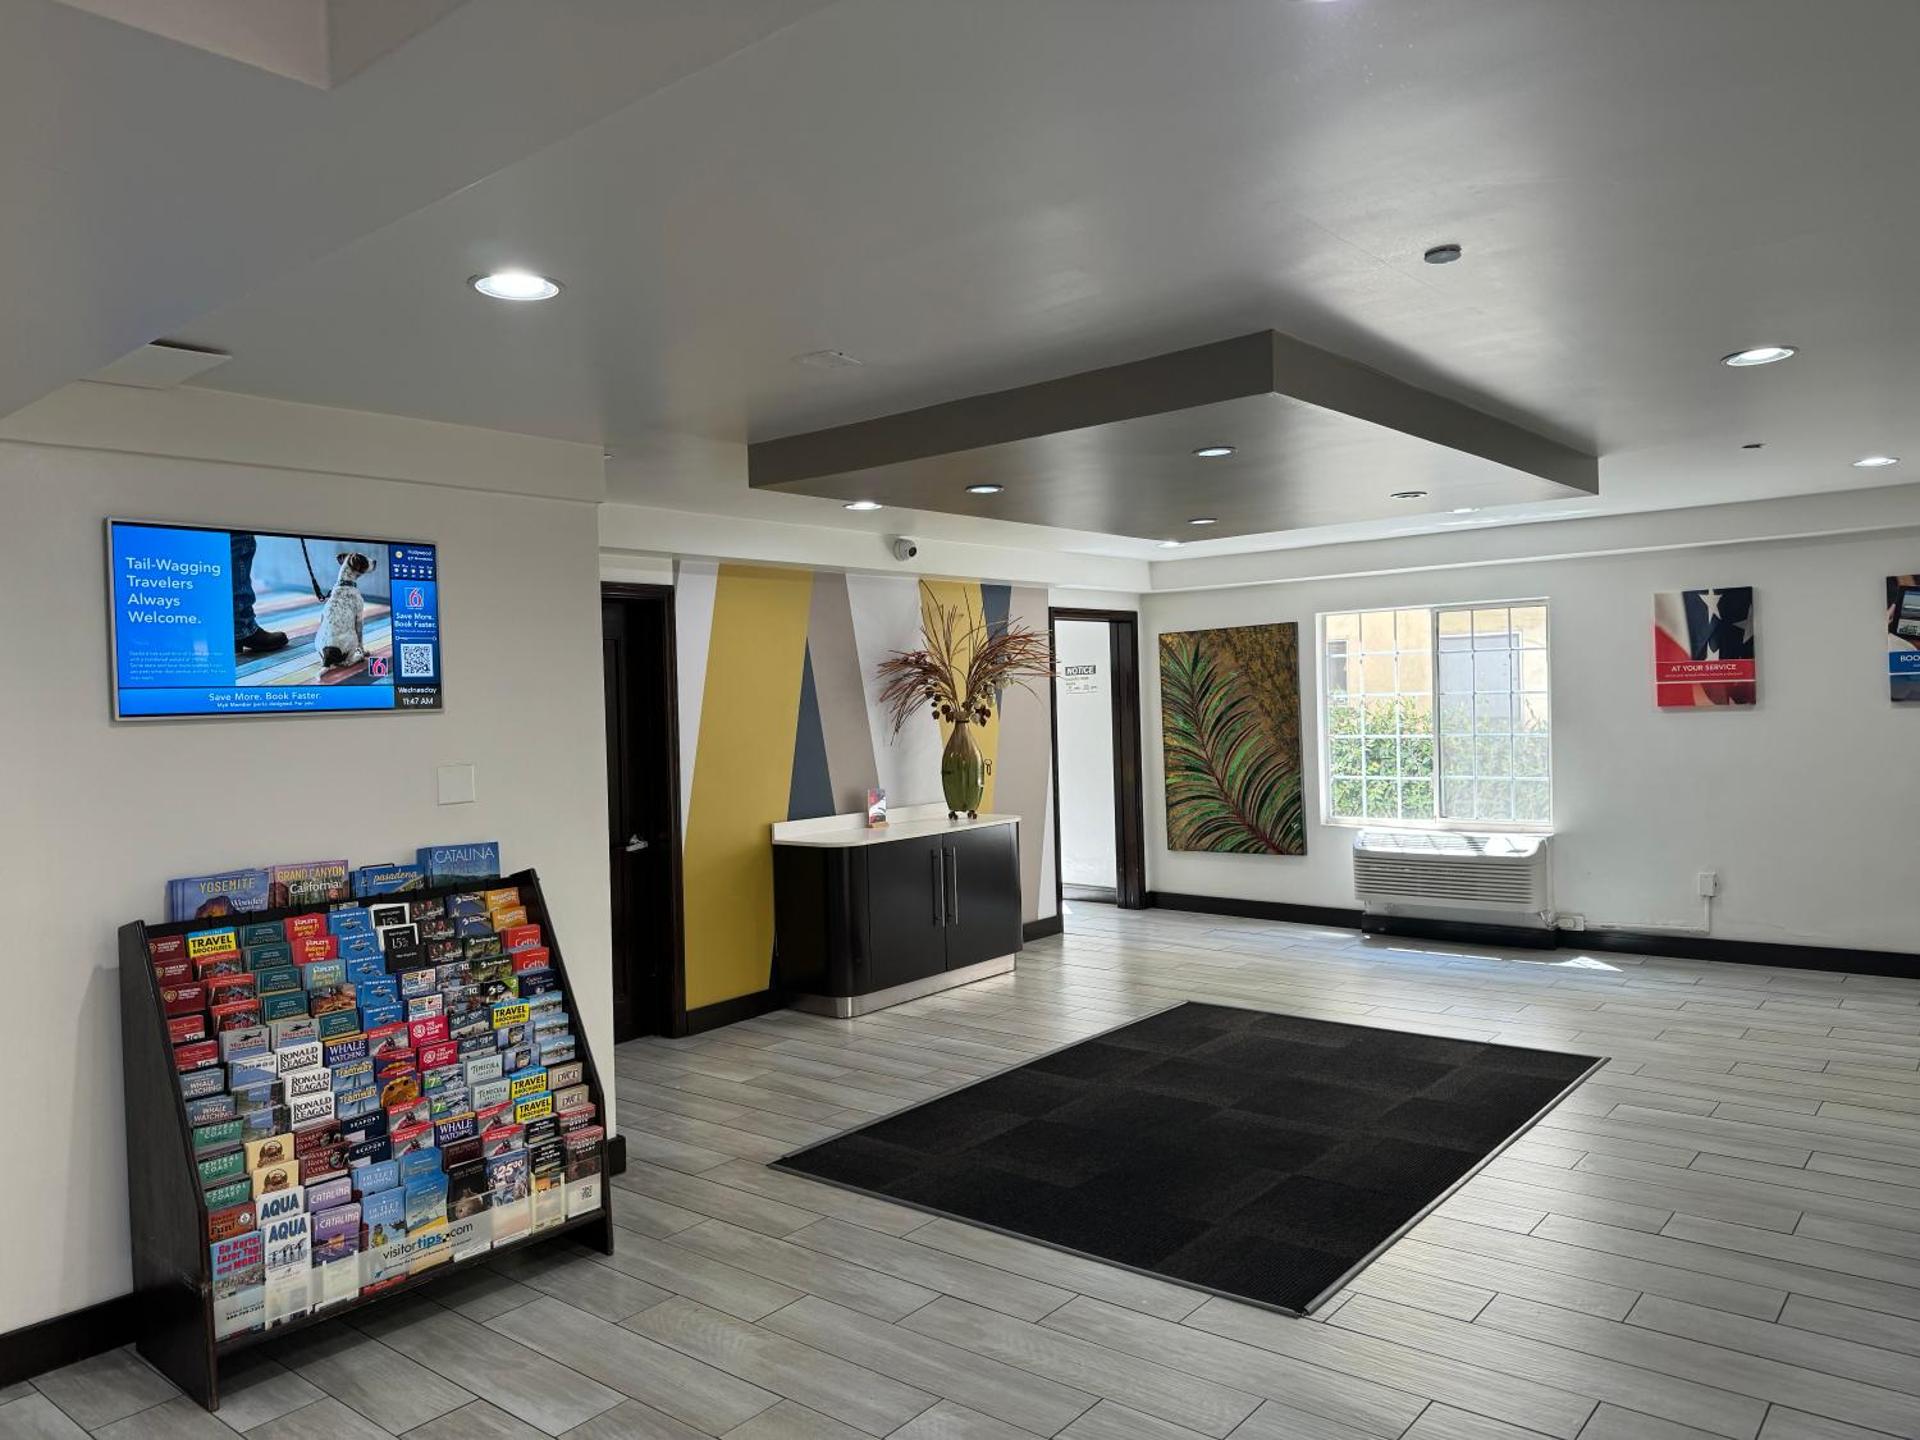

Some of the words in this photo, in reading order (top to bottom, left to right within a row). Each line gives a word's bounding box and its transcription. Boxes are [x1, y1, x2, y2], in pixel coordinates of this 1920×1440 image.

[126, 557, 221, 576] Tail-Wagging
[126, 575, 194, 589] Travelers
[128, 592, 181, 609] Always
[128, 610, 202, 624] Welcome.
[1066, 667, 1095, 675] NOTICE
[208, 693, 231, 701] Save
[265, 691, 289, 700] Book
[420, 697, 434, 705] AM
[434, 847, 495, 864] CATALINA
[278, 870, 308, 882] GRAND
[309, 865, 346, 879] CANYON
[200, 877, 256, 894] YOSEMITE
[191, 935, 233, 948] TRAVEL
[193, 944, 233, 955] BROCHURES
[495, 1005, 526, 1017] TRAVEL
[280, 1047, 319, 1061] RONALD
[329, 1040, 366, 1055] WHALE
[280, 1054, 319, 1070] REAGAN
[190, 1079, 215, 1090] WHALE
[291, 1073, 330, 1086] RONALD
[513, 1075, 545, 1088] TRAVEL
[291, 1080, 330, 1094] REAGAN
[203, 1105, 226, 1114] WHALE
[293, 1097, 332, 1112] RONALD
[520, 1098, 550, 1112] TRAVEL
[293, 1104, 333, 1121] REAGAN
[200, 1122, 240, 1135] CENTRAL
[439, 1119, 473, 1135] WHALE
[204, 1129, 233, 1140] COAST
[199, 1155, 240, 1171] CENTRAL
[204, 1162, 233, 1175] COAST
[206, 1183, 247, 1199] CENTRAL
[211, 1190, 240, 1203] COAST
[310, 1186, 351, 1204] CATALINA
[260, 1193, 299, 1220] AQUA
[319, 1211, 360, 1229] CATALINA
[268, 1217, 308, 1243] AQUA
